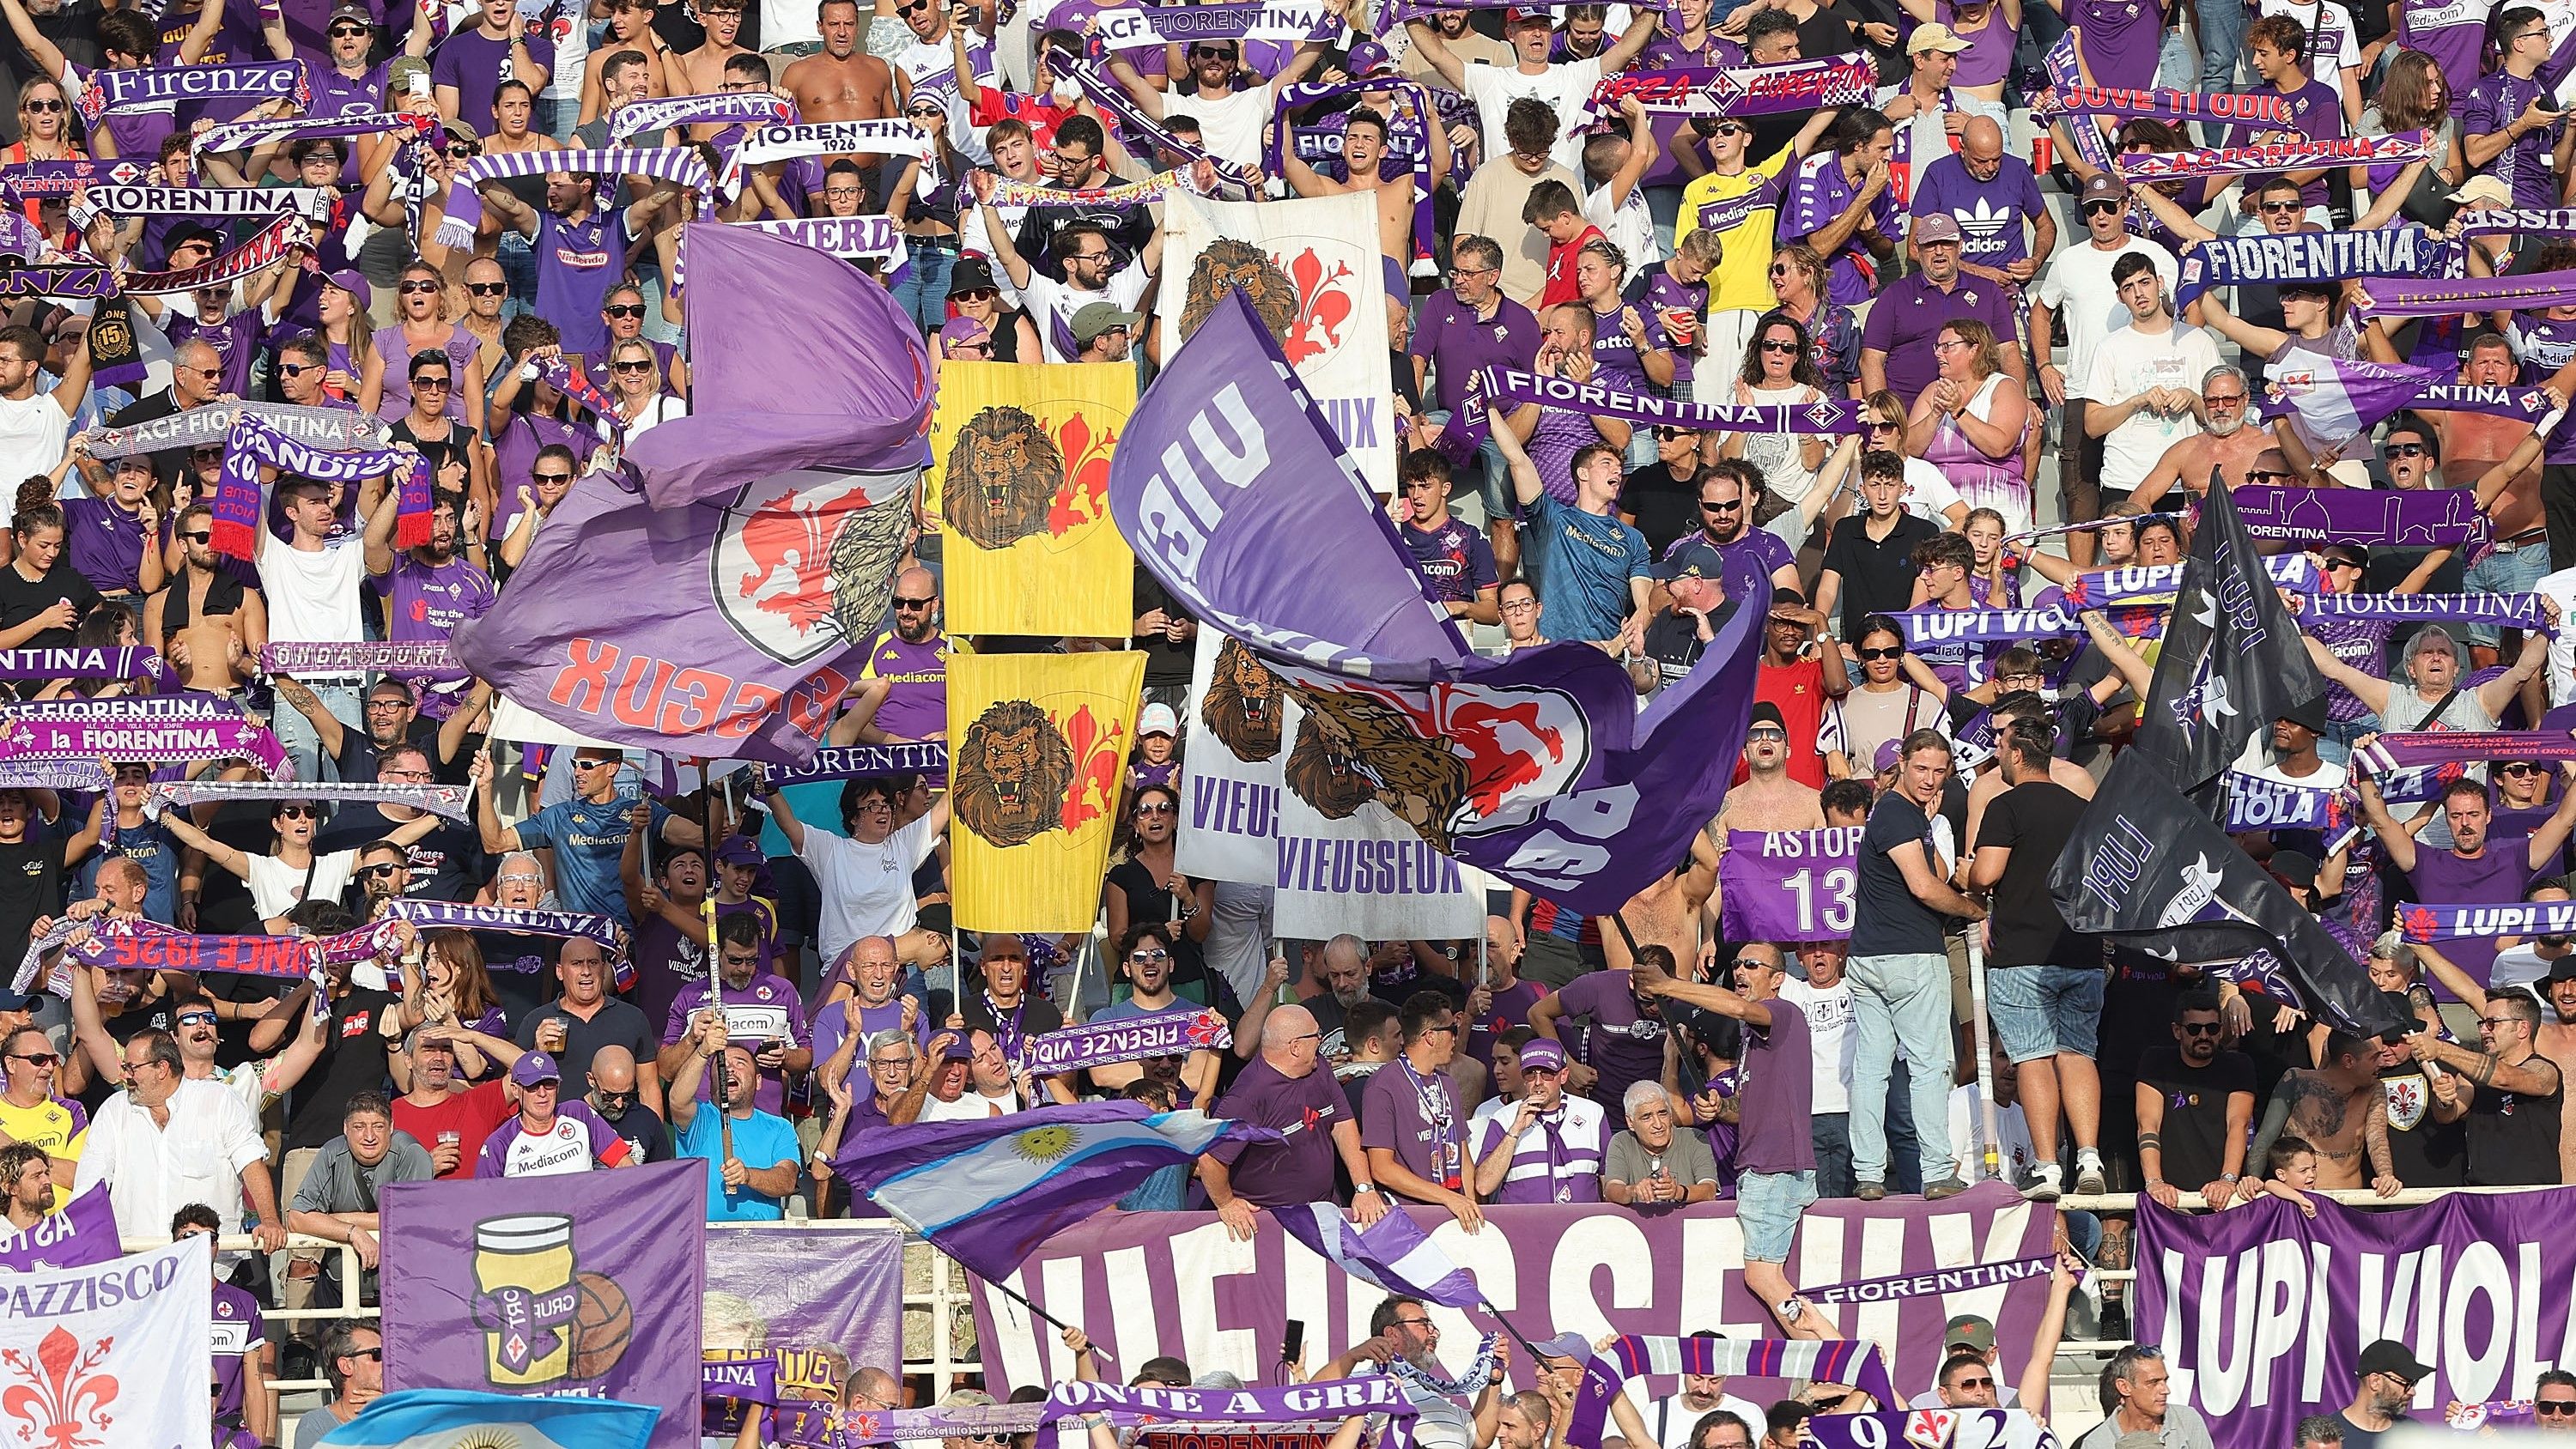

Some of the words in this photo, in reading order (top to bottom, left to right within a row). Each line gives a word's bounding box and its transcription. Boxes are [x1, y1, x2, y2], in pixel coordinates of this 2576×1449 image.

[1102, 19, 1140, 40] ACF
[1149, 7, 1314, 34] FIORENTINA
[104, 67, 294, 103] Firenze
[1592, 74, 1690, 108] ORZA
[622, 99, 771, 128] ORENTINA
[2062, 87, 2155, 112] JUVE
[2168, 92, 2201, 115] TI
[744, 122, 927, 151] IORENTINA
[823, 138, 857, 151] 1926
[19, 177, 99, 192] ENTINA
[88, 187, 300, 212] FIORENTINA
[780, 217, 896, 253] MERD
[2210, 227, 2416, 282] FIORENTINA
[1507, 370, 1765, 425] FIORENTINA
[136, 415, 181, 441] ACF
[222, 485, 258, 504] CLUB
[220, 501, 257, 520] VIOLA
[427, 606, 447, 619] Save
[447, 608, 465, 619] the
[2312, 592, 2538, 622] FIORENTINA
[1912, 610, 1991, 642] LUPI
[1935, 646, 1964, 658] diaco
[82, 728, 220, 749] FIORENTINA
[764, 743, 947, 782] FIORENTIN
[404, 877, 432, 894] OMPANY
[408, 867, 439, 876] ARMENTS
[1781, 867, 1856, 934] 13
[441, 902, 617, 939] FIORENZA
[2454, 907, 2535, 937] LUPI
[115, 937, 201, 967] 1926
[727, 1018, 768, 1031] iacom
[1080, 1024, 1179, 1057] FIRENZE
[1823, 1260, 2052, 1303] FIORENTINA
[2163, 1238, 2331, 1418] LUPI
[1046, 1382, 1204, 1415] ONTE
[1222, 1392, 1265, 1415] A
[894, 1422, 981, 1440] ORGOGLIOSI
[991, 1422, 1007, 1438] DI
[1149, 1434, 1334, 1449] FIORENTIN
